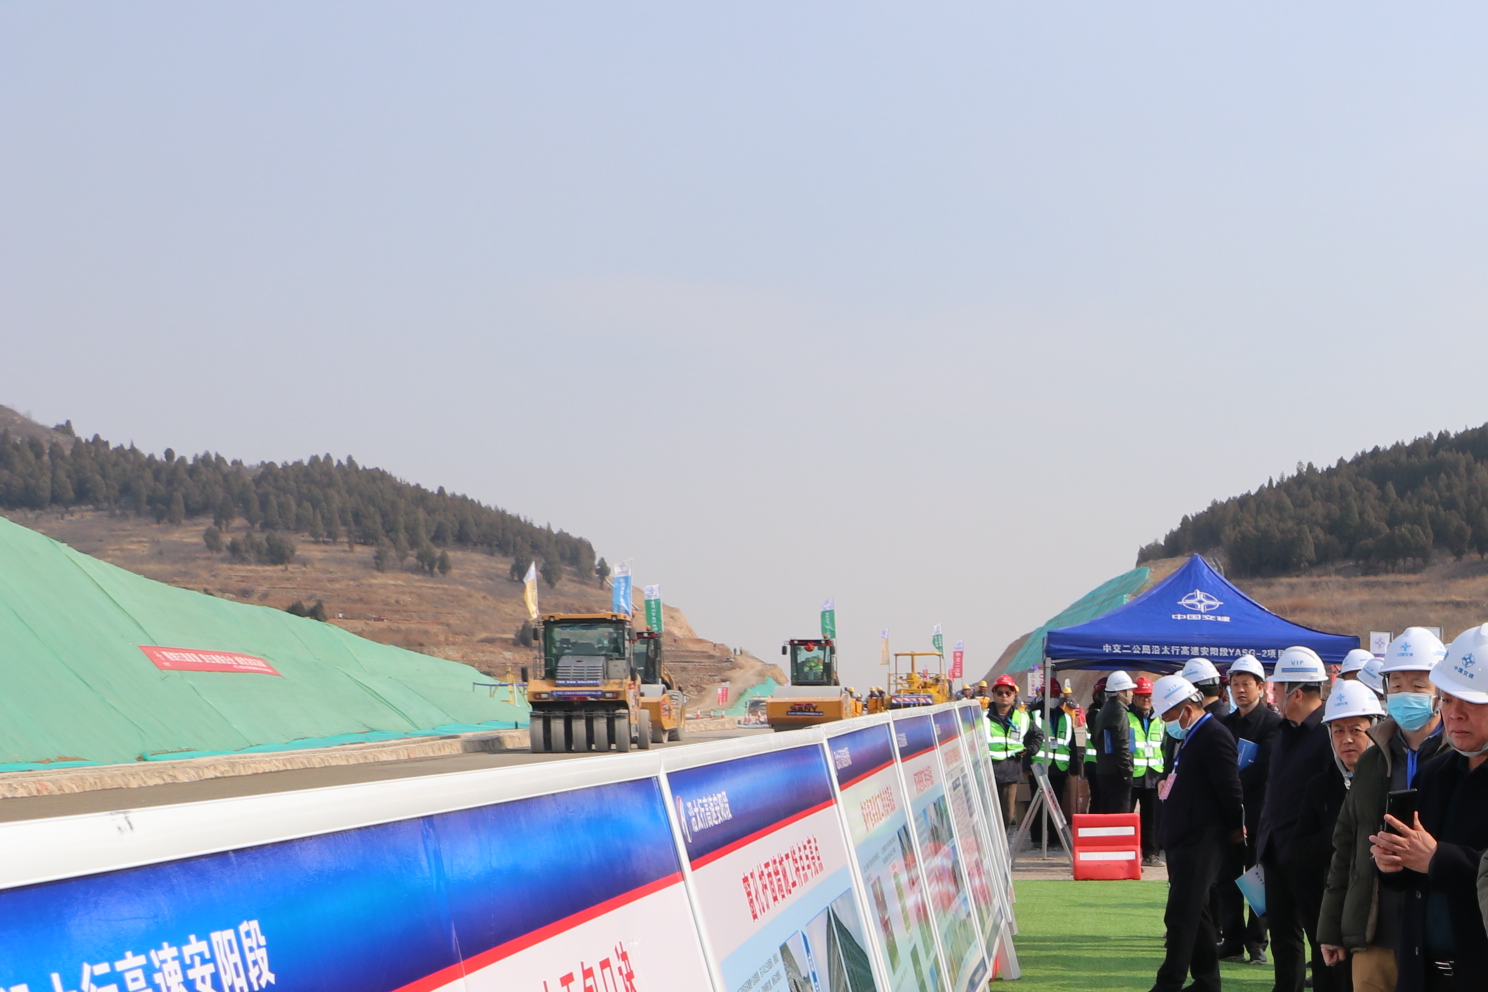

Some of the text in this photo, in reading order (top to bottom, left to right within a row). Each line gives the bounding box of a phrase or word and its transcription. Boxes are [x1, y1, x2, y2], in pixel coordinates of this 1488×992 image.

[1172, 613, 1231, 623] 中国交建
[1453, 665, 1475, 680] 中国交建
